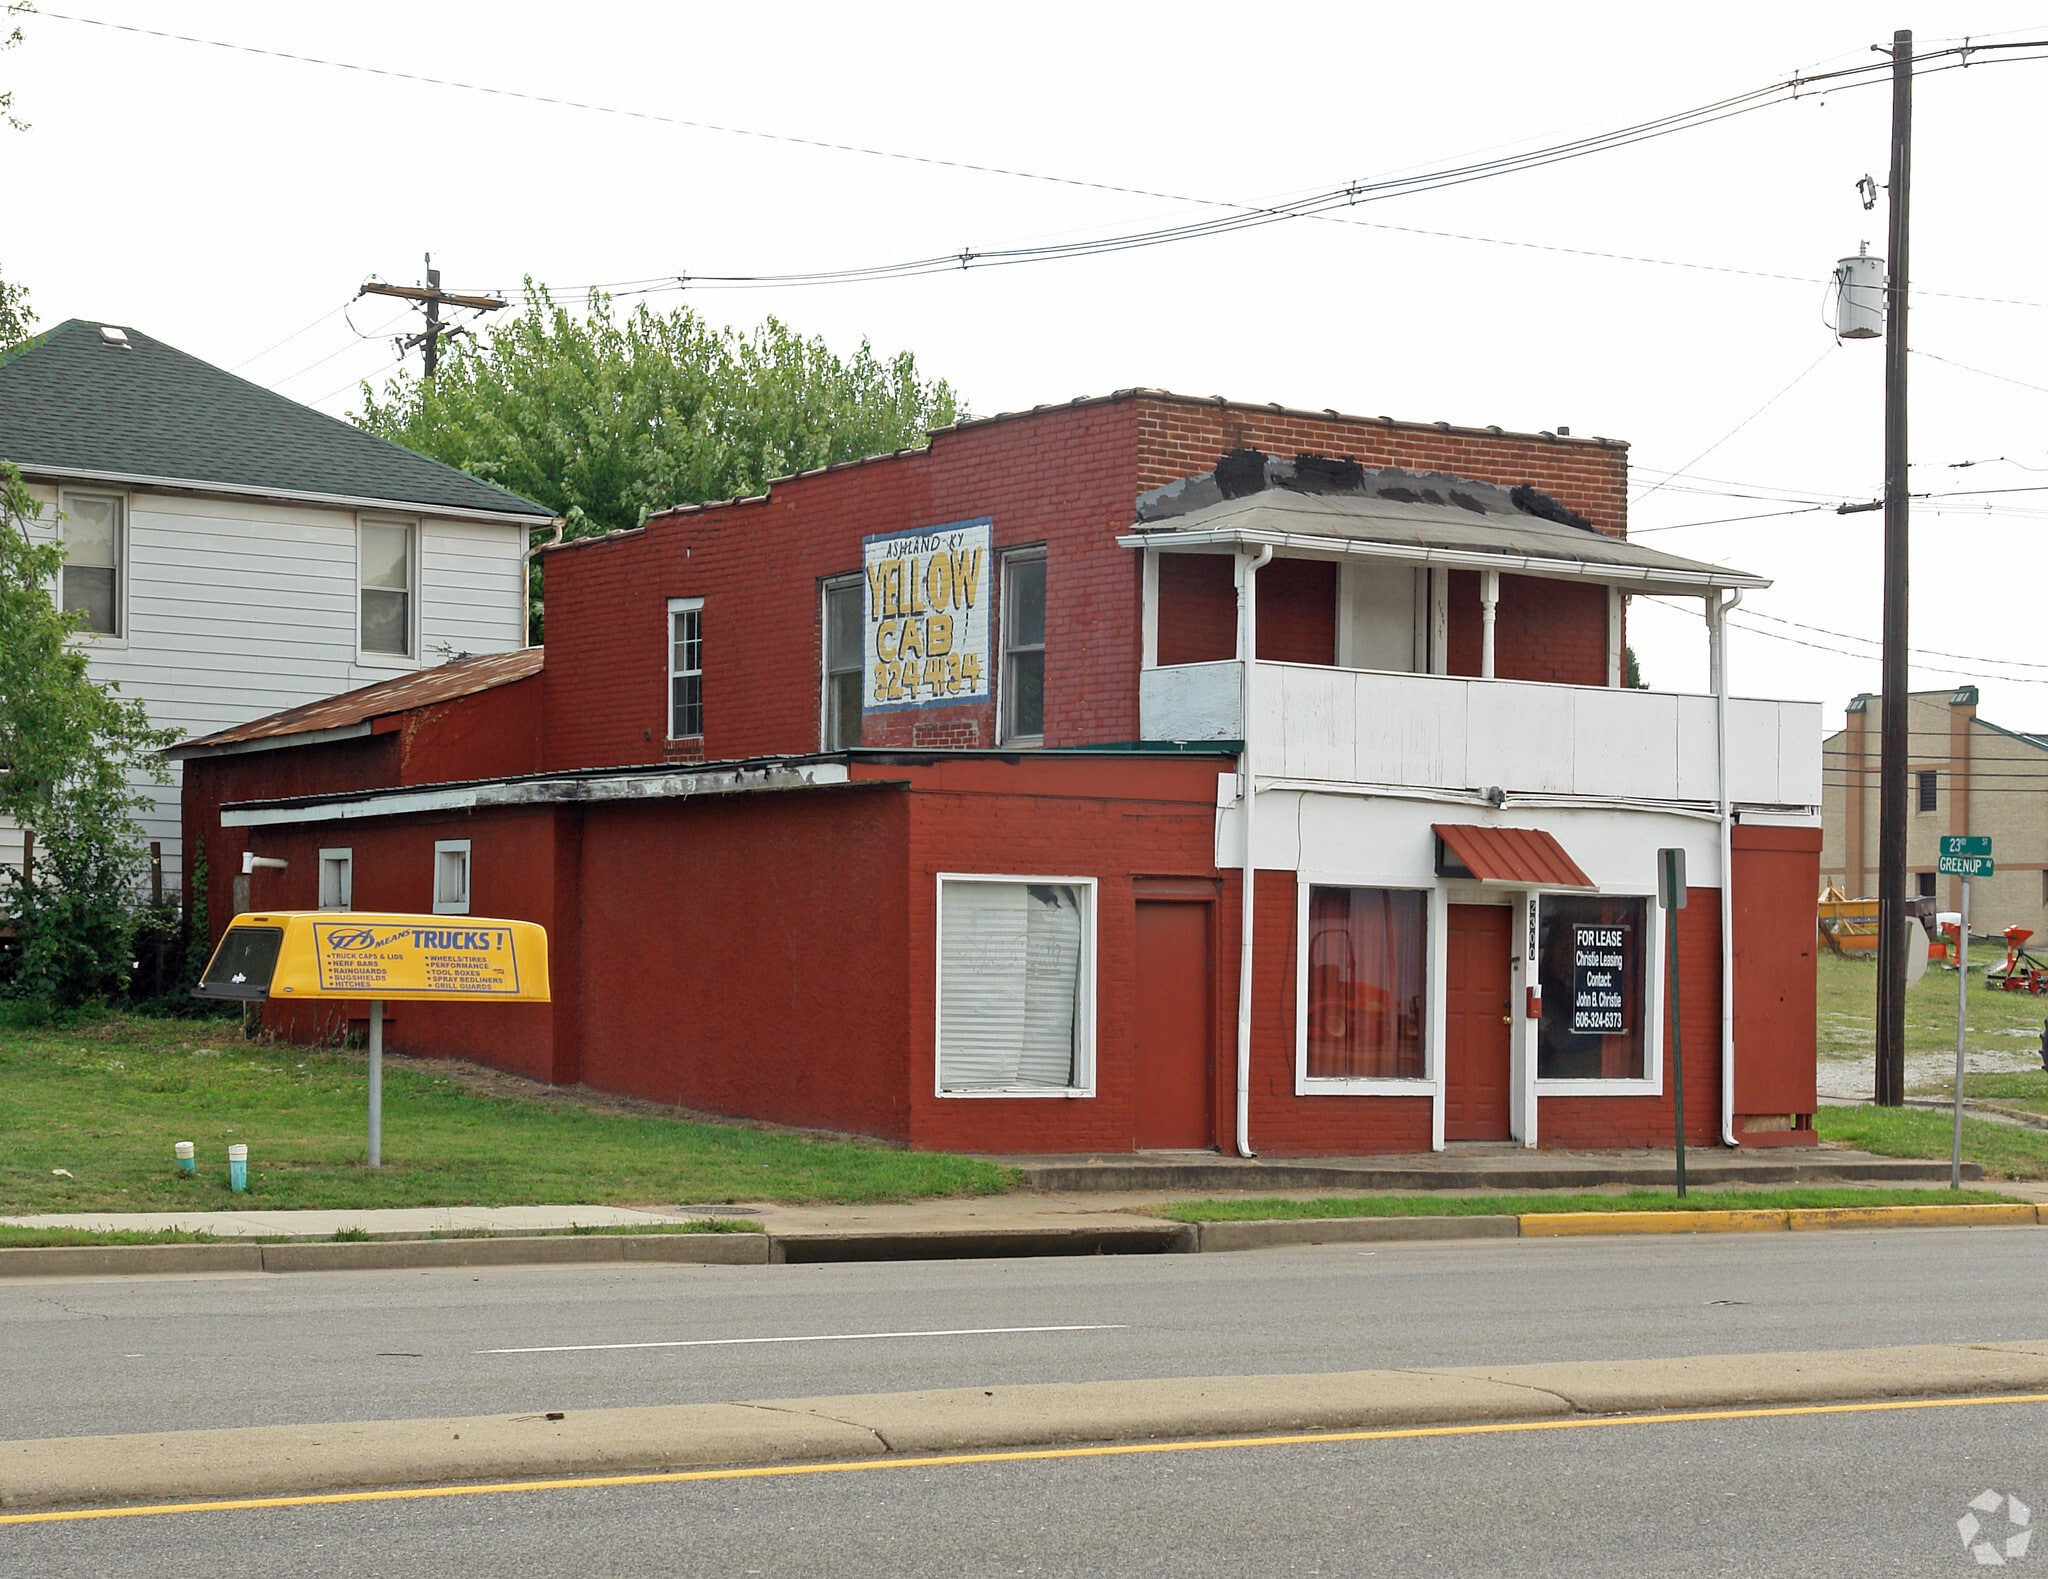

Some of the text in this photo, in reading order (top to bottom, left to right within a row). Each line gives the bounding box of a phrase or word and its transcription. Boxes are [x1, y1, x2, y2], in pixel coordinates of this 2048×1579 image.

[886, 536, 940, 559] ASHLAND
[867, 546, 982, 622] YELLOW
[876, 614, 953, 664] CAB
[1982, 838, 1988, 846] ST
[1940, 857, 1982, 873] GREENUP
[375, 929, 411, 949] MEANS
[1577, 930, 1622, 947] FOR LEASE
[430, 962, 489, 970] PERFORMANCE
[1575, 950, 1623, 970] Christie Leasing
[460, 976, 503, 984] BEDLINERS
[1576, 992, 1591, 1008] John
[1598, 992, 1622, 1008] Christie
[1575, 1011, 1622, 1028] 606-324-6373
